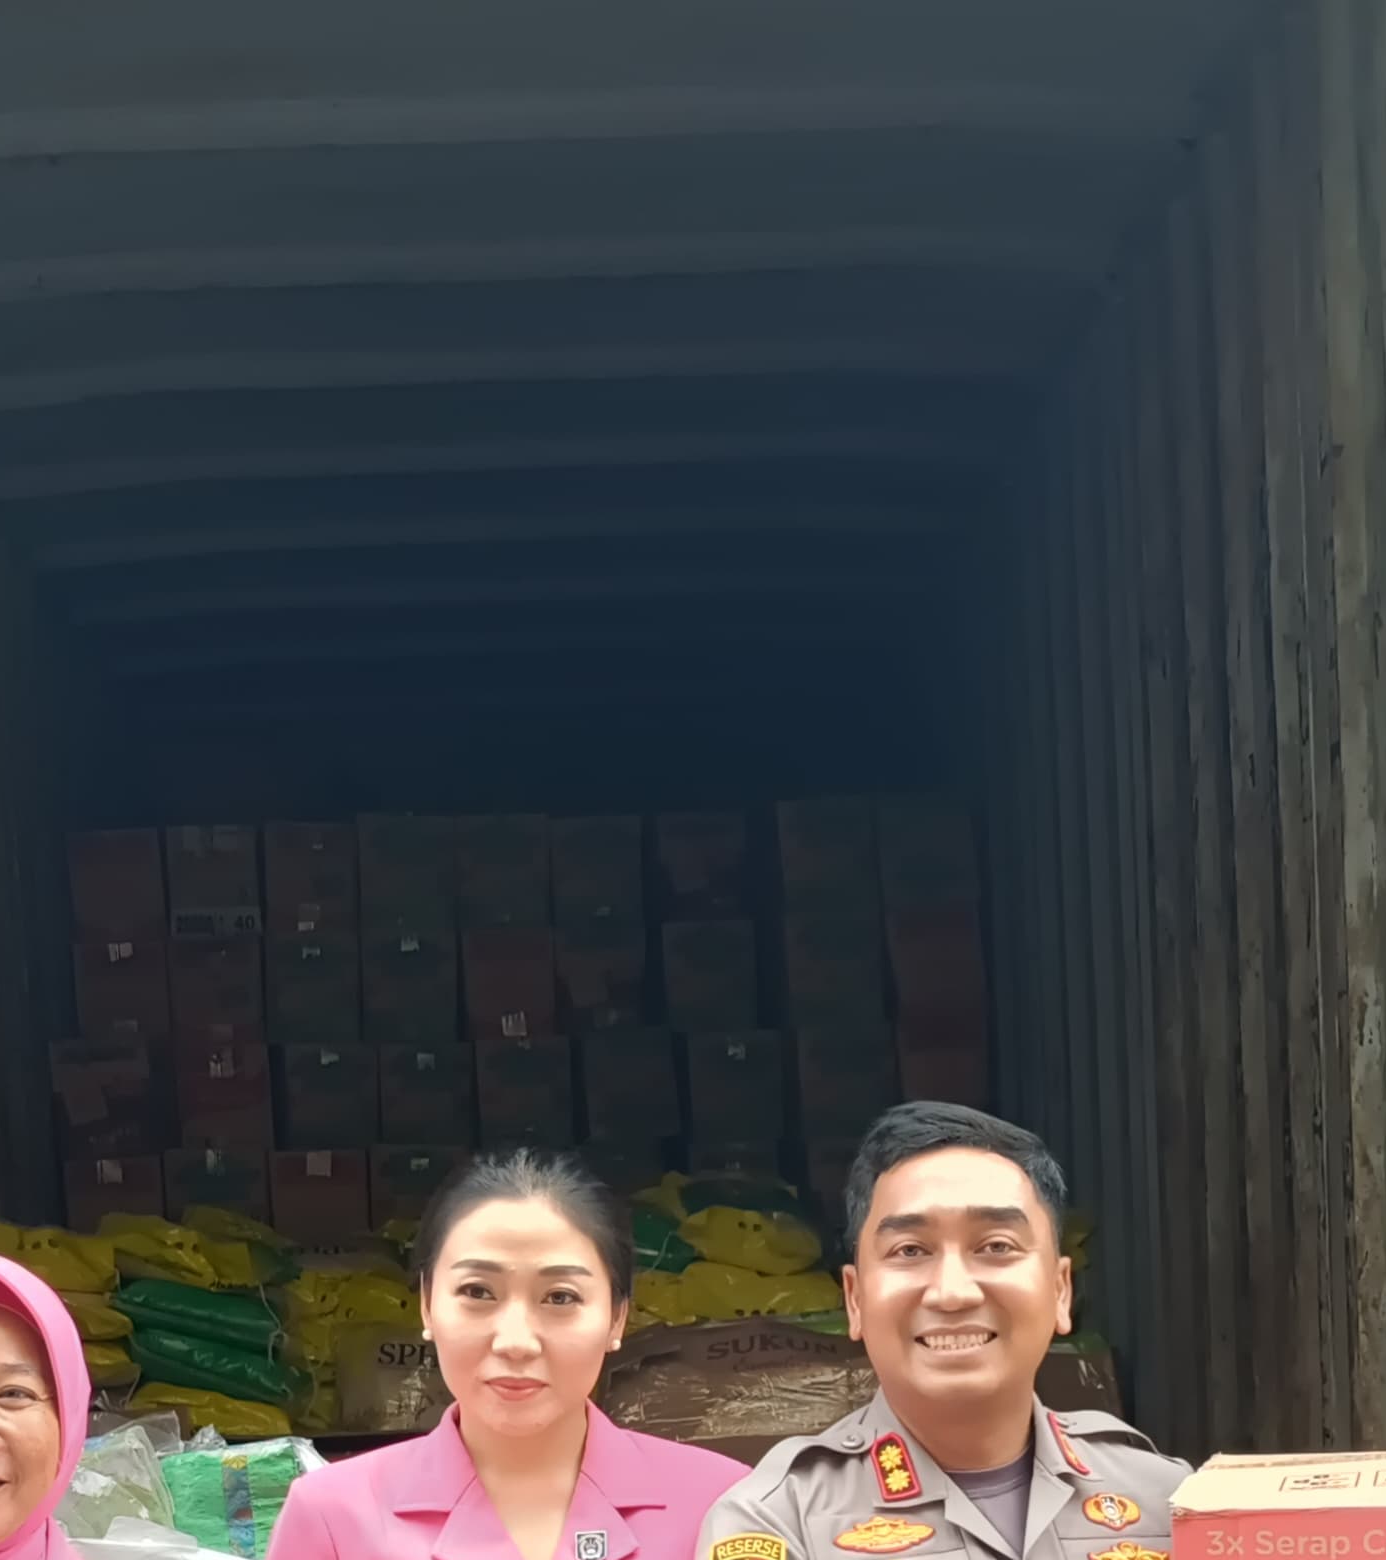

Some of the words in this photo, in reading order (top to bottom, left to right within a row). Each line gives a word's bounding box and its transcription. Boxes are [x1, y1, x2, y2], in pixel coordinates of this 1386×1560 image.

[716, 1539, 781, 1560] RESERSE
[1206, 1530, 1244, 1556] 3x
[1254, 1530, 1351, 1560] Serap
